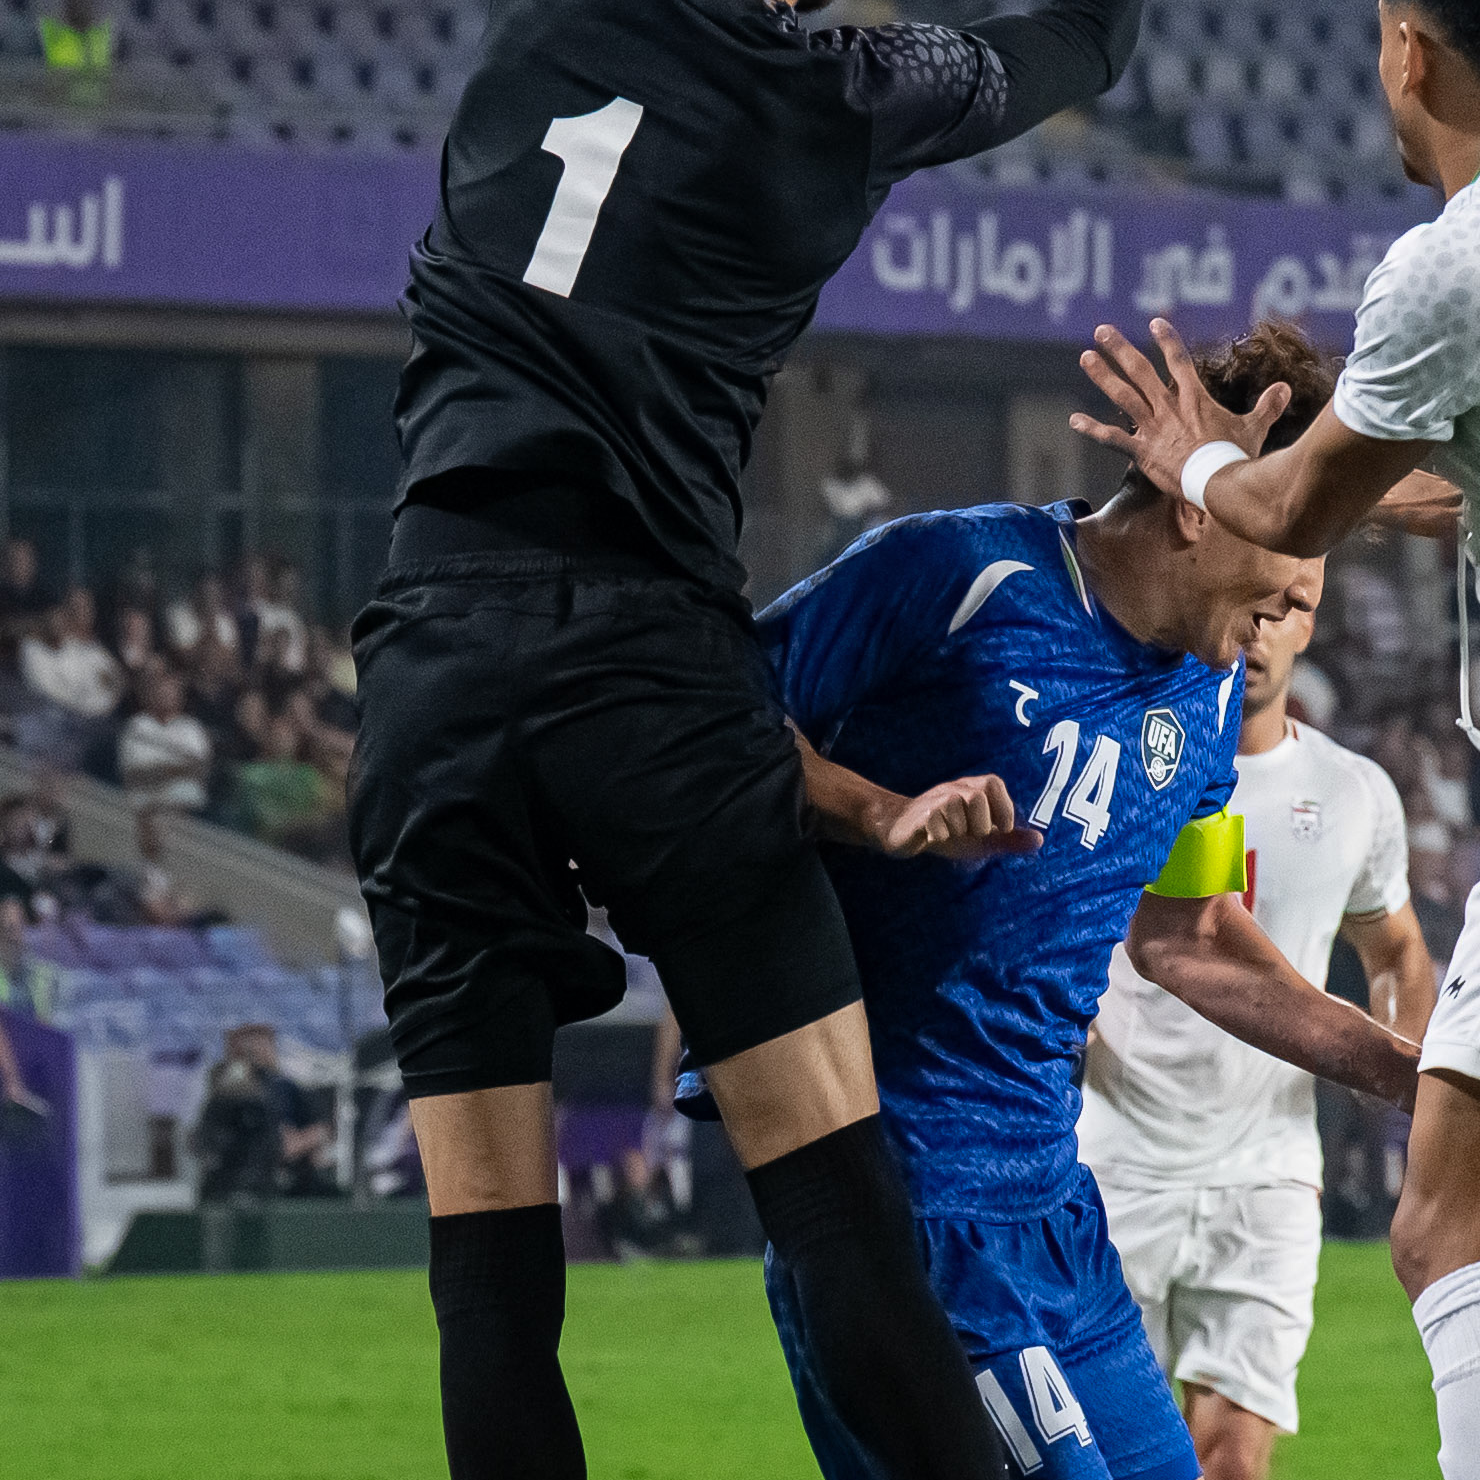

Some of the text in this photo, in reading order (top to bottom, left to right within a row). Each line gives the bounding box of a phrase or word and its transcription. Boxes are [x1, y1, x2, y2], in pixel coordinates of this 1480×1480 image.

[523, 96, 643, 298] 1
[1028, 720, 1121, 851] 14
[1148, 719, 1176, 759] UFA
[975, 1346, 1092, 1476] 14
